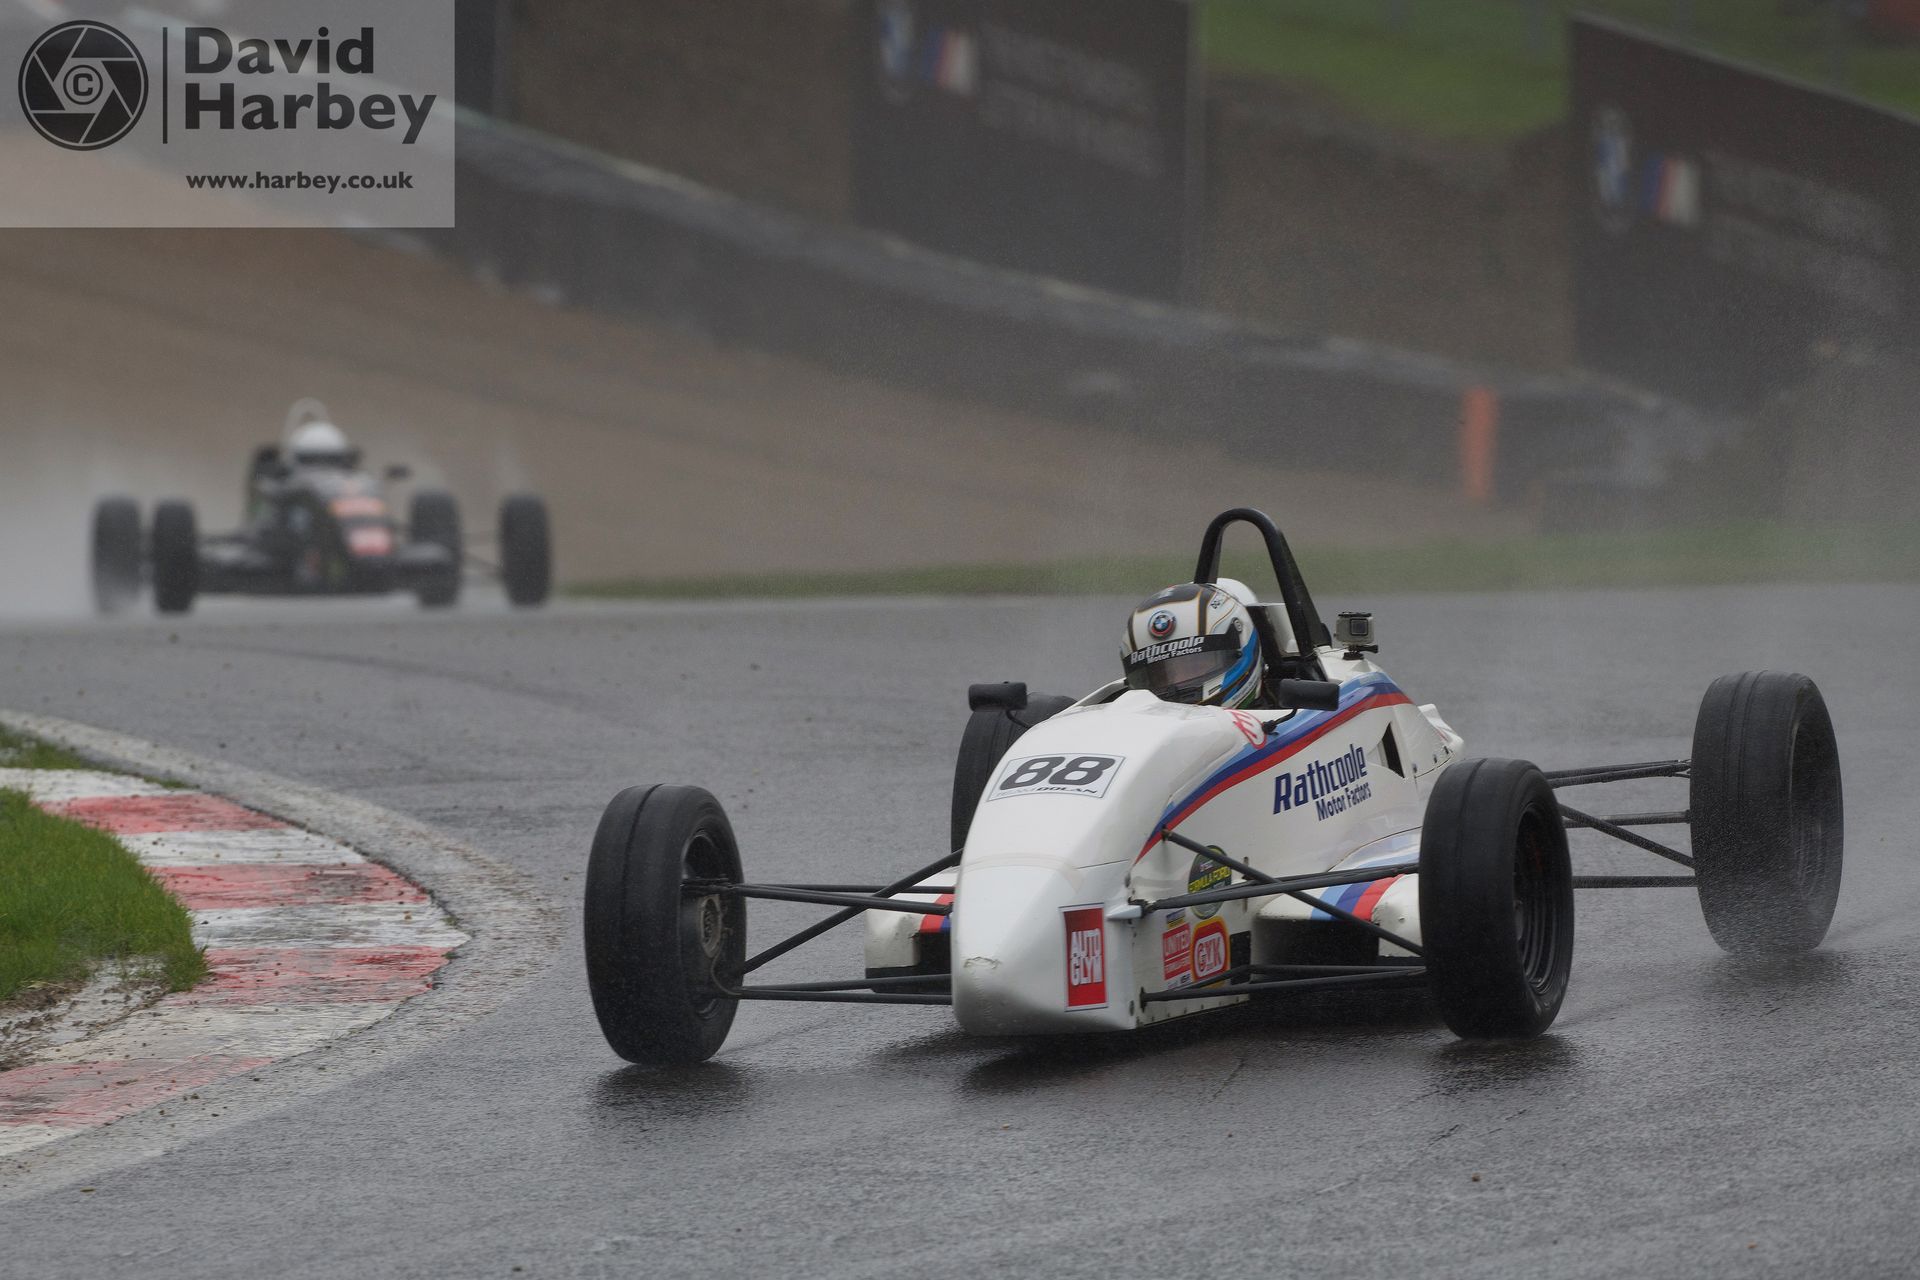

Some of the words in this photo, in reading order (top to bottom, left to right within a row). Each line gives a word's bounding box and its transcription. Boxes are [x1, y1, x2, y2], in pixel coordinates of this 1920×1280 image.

[1131, 636, 1204, 664] Rathcoole
[1147, 653, 1170, 664] Motor
[1171, 646, 1202, 657] Factors
[1000, 756, 1115, 790] 88
[1273, 743, 1368, 815] Rathcoole
[1037, 786, 1097, 794] DOLAN
[1316, 793, 1346, 821] Motor
[1348, 781, 1372, 808] Factors
[1071, 928, 1103, 958] AUTO
